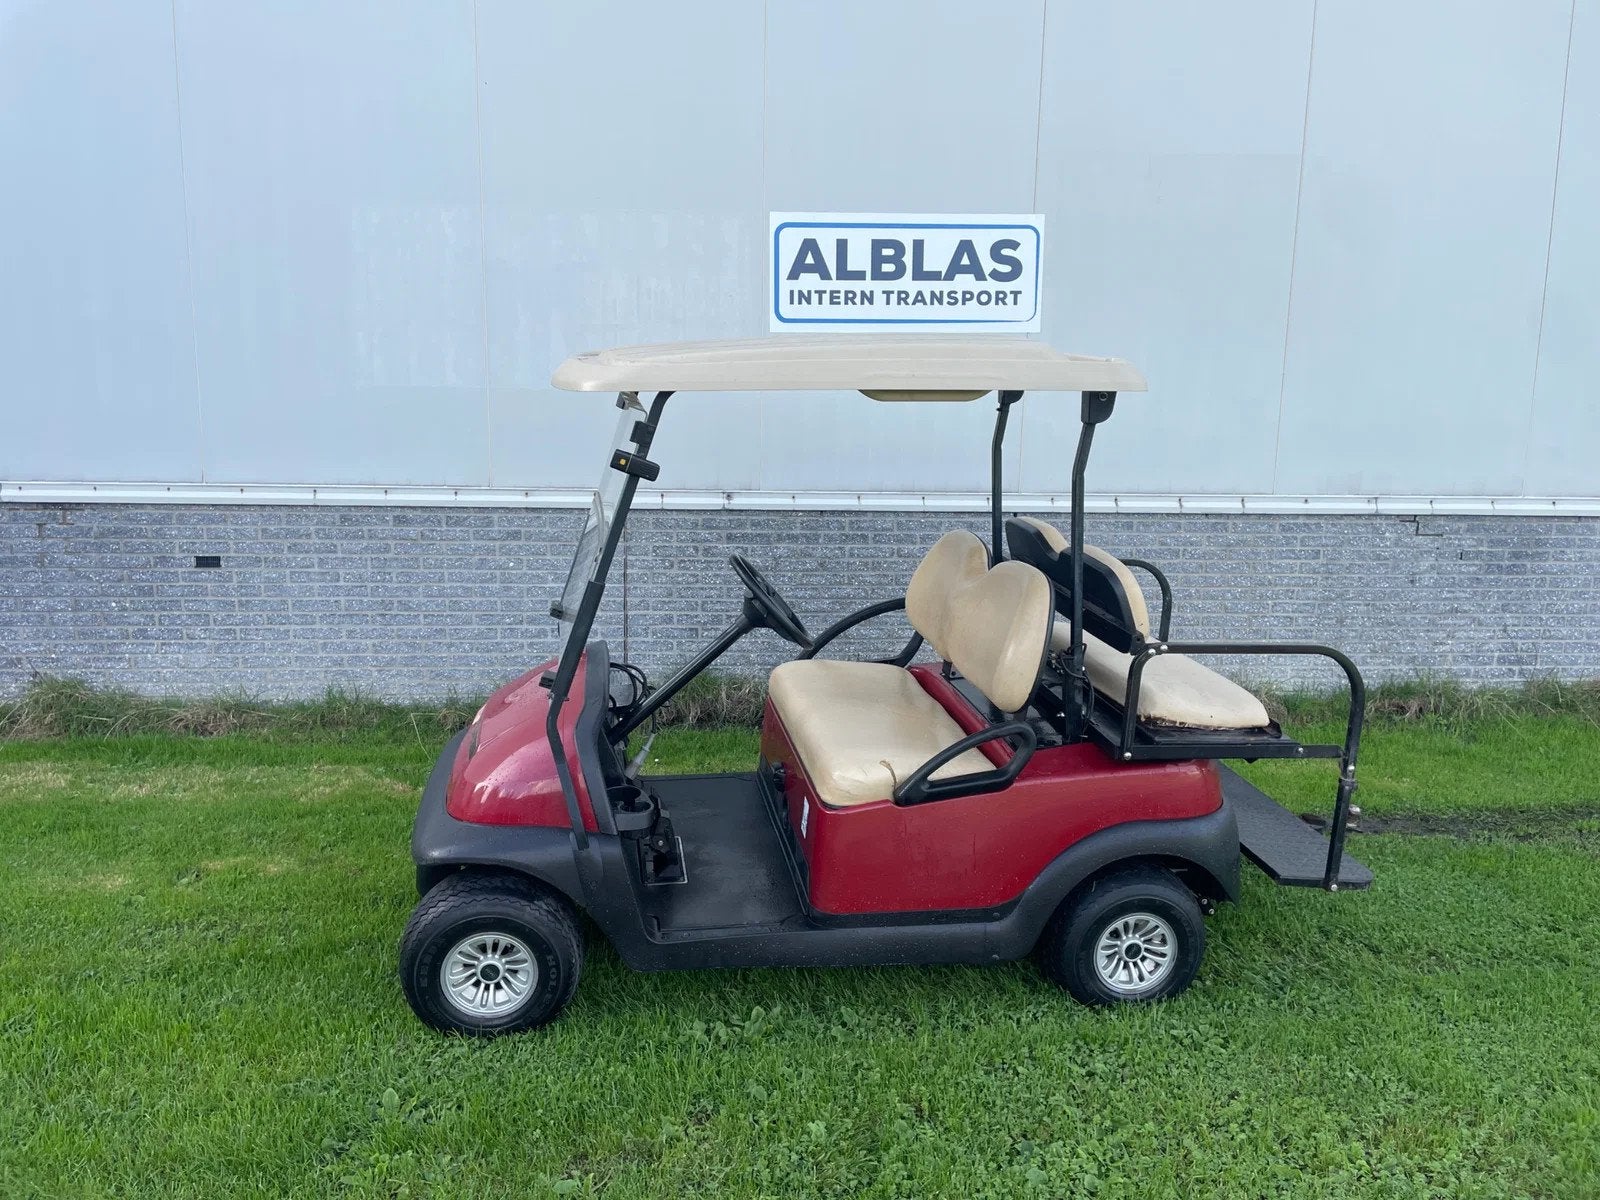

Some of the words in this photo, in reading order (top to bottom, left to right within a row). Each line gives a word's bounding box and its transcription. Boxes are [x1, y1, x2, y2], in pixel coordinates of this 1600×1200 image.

[786, 238, 1024, 283] ALBLAS
[789, 289, 875, 306] INTERN
[882, 289, 1023, 307] TRANSPORT
